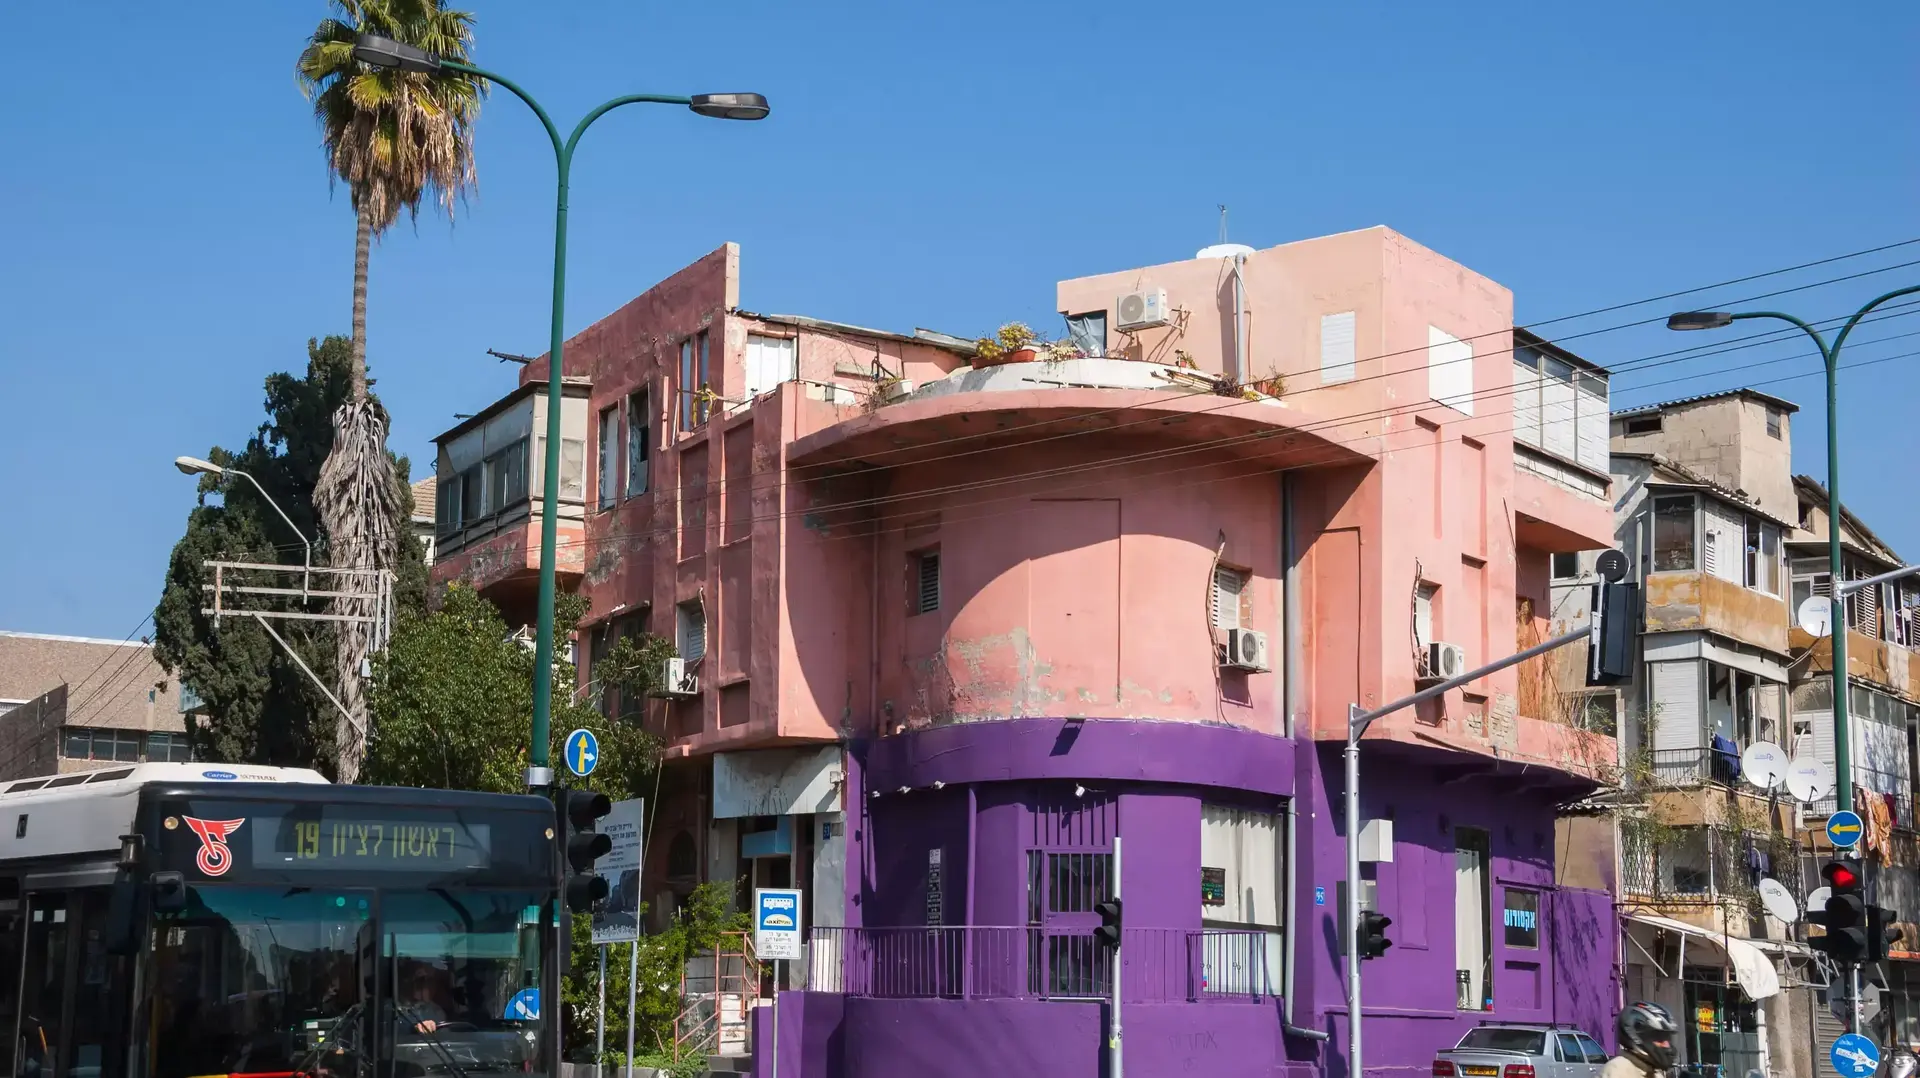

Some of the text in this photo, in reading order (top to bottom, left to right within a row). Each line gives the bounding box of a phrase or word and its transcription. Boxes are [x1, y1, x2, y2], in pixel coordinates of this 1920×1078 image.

[295, 822, 455, 859] ראשון לציון 19
[1504, 909, 1535, 931] אקסודוס
